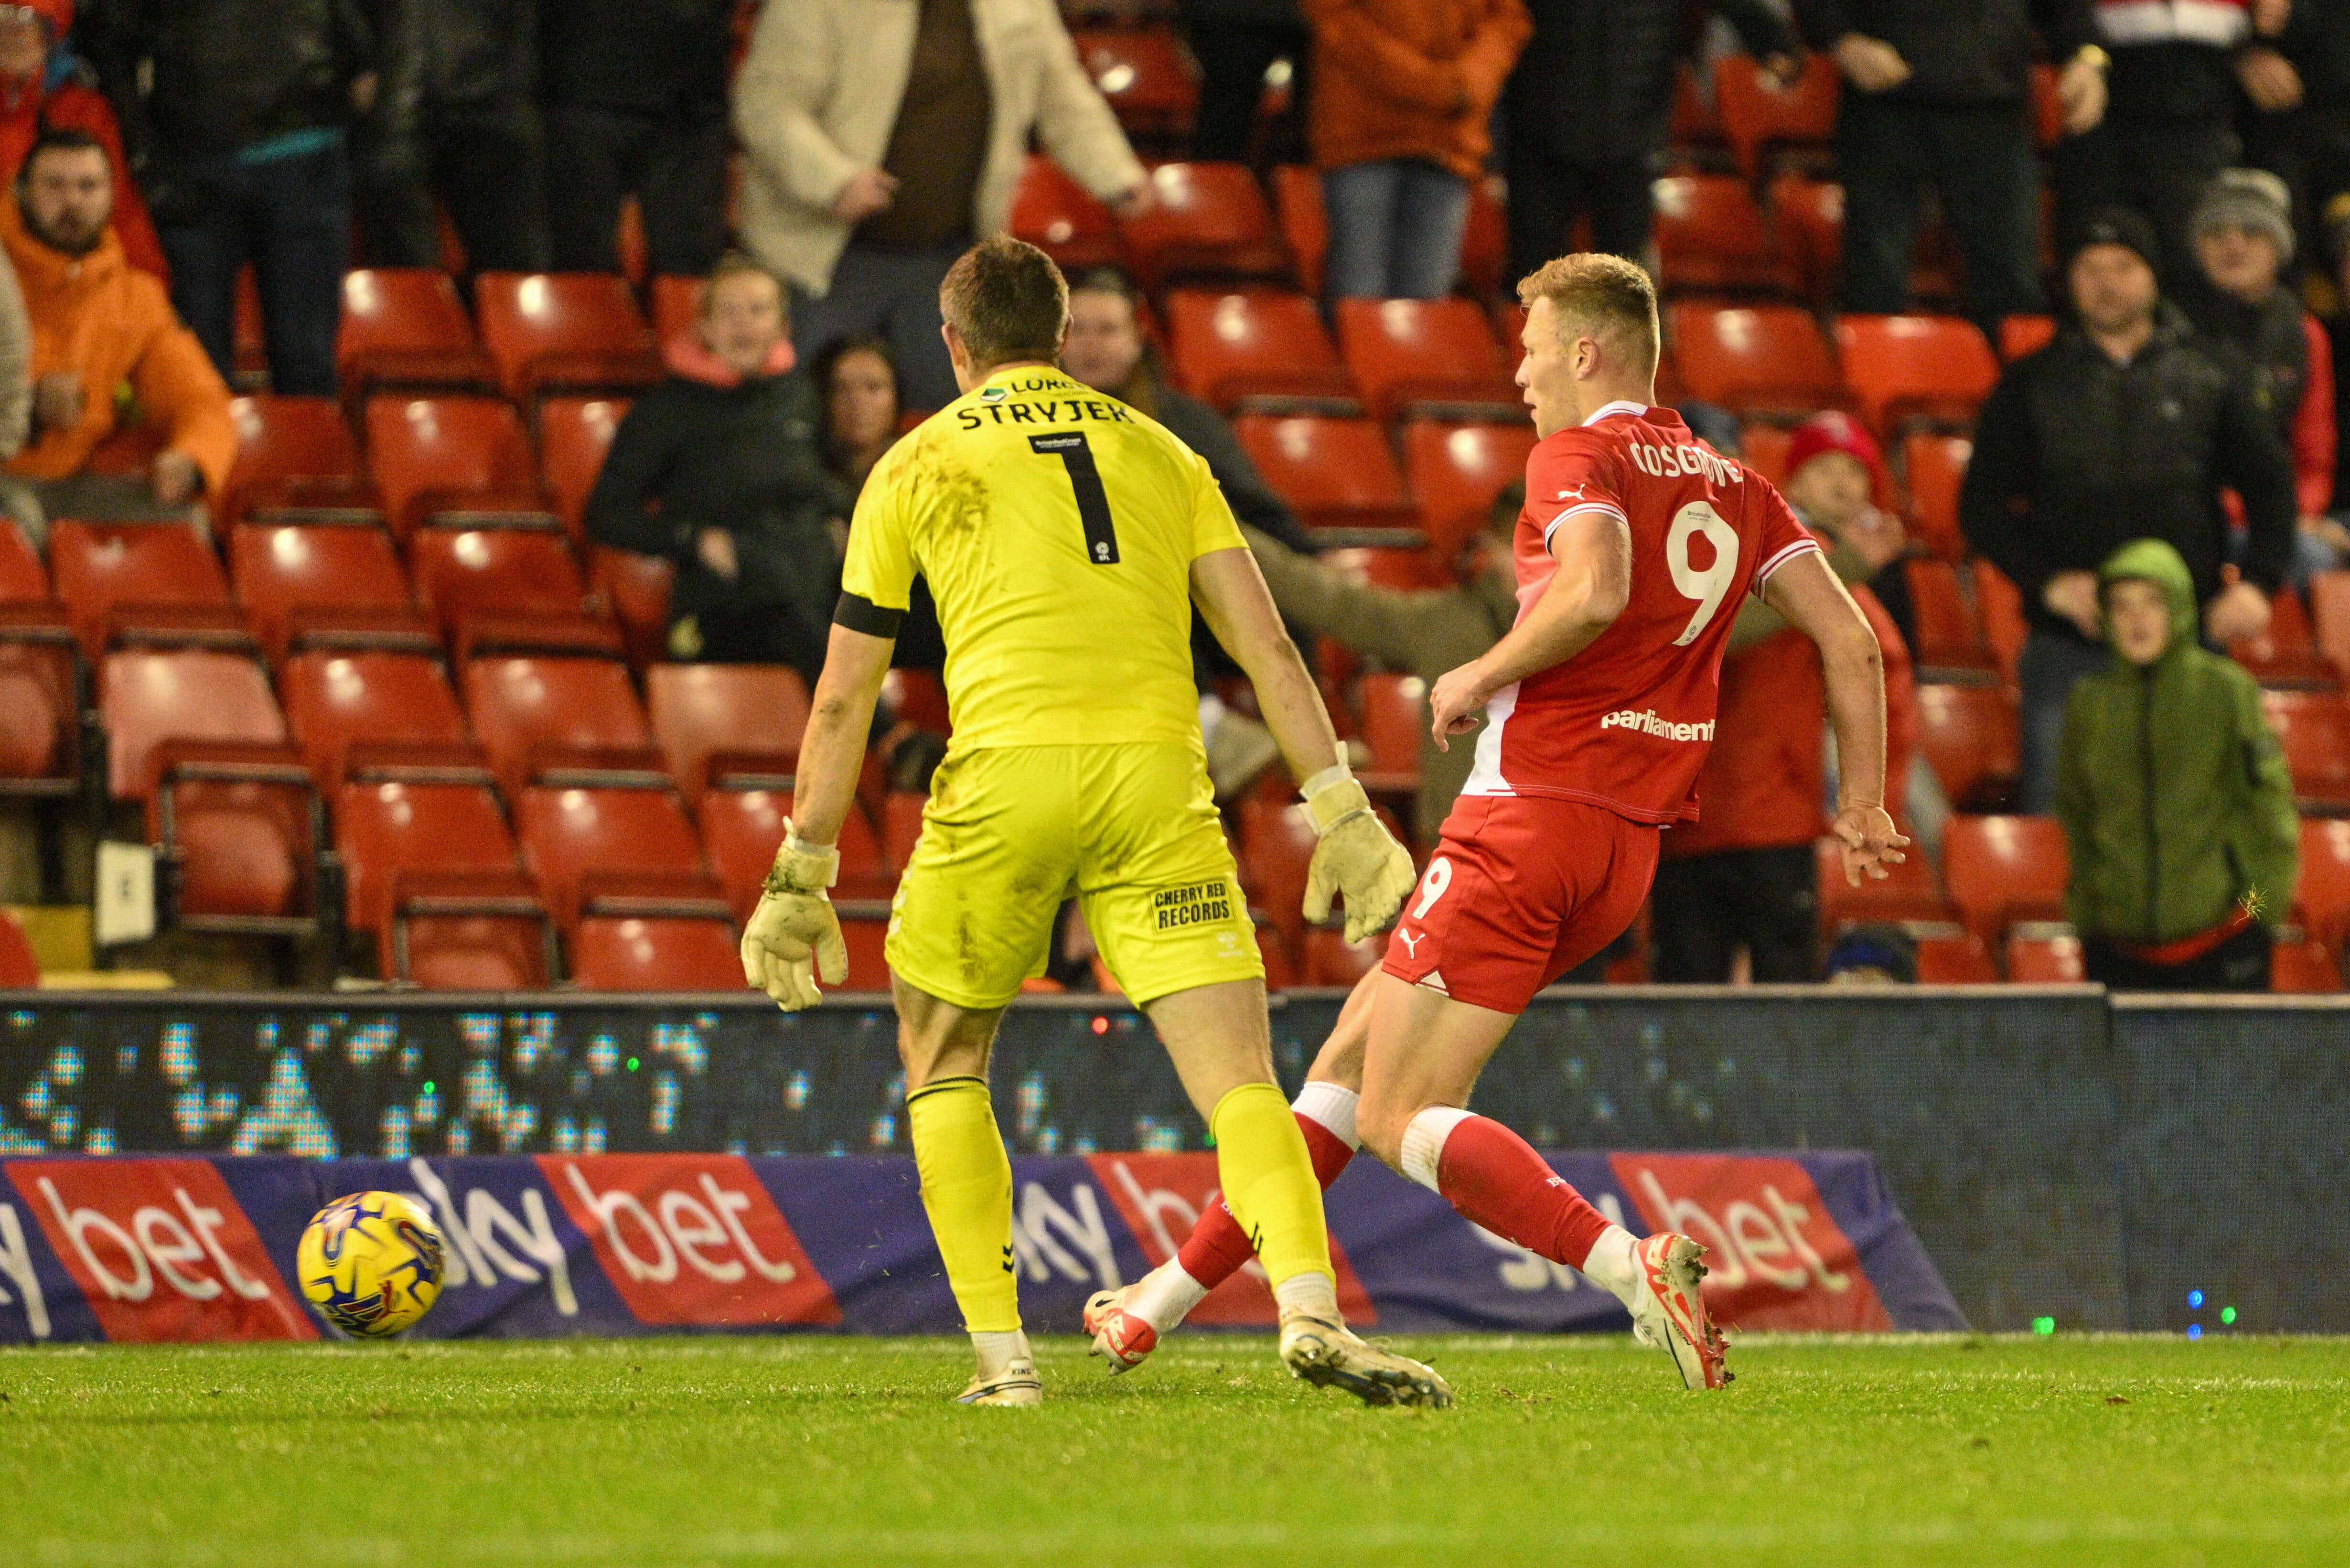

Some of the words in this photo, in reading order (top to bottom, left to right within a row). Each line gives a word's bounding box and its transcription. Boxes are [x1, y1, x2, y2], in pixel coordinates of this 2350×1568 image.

[957, 400, 1136, 430] STRYJEK
[1027, 430, 1120, 564] 1
[1667, 501, 1740, 646] 9
[1601, 709, 1716, 742] parliament
[1155, 886, 1203, 907] CHERRY
[1206, 882, 1226, 898] RED
[1159, 900, 1230, 929] RECORDS
[1413, 857, 1453, 920] 9
[38, 1176, 270, 1301] bet
[565, 1162, 796, 1284] bet
[1012, 1182, 1124, 1292] ky
[1638, 1169, 1850, 1292] bet
